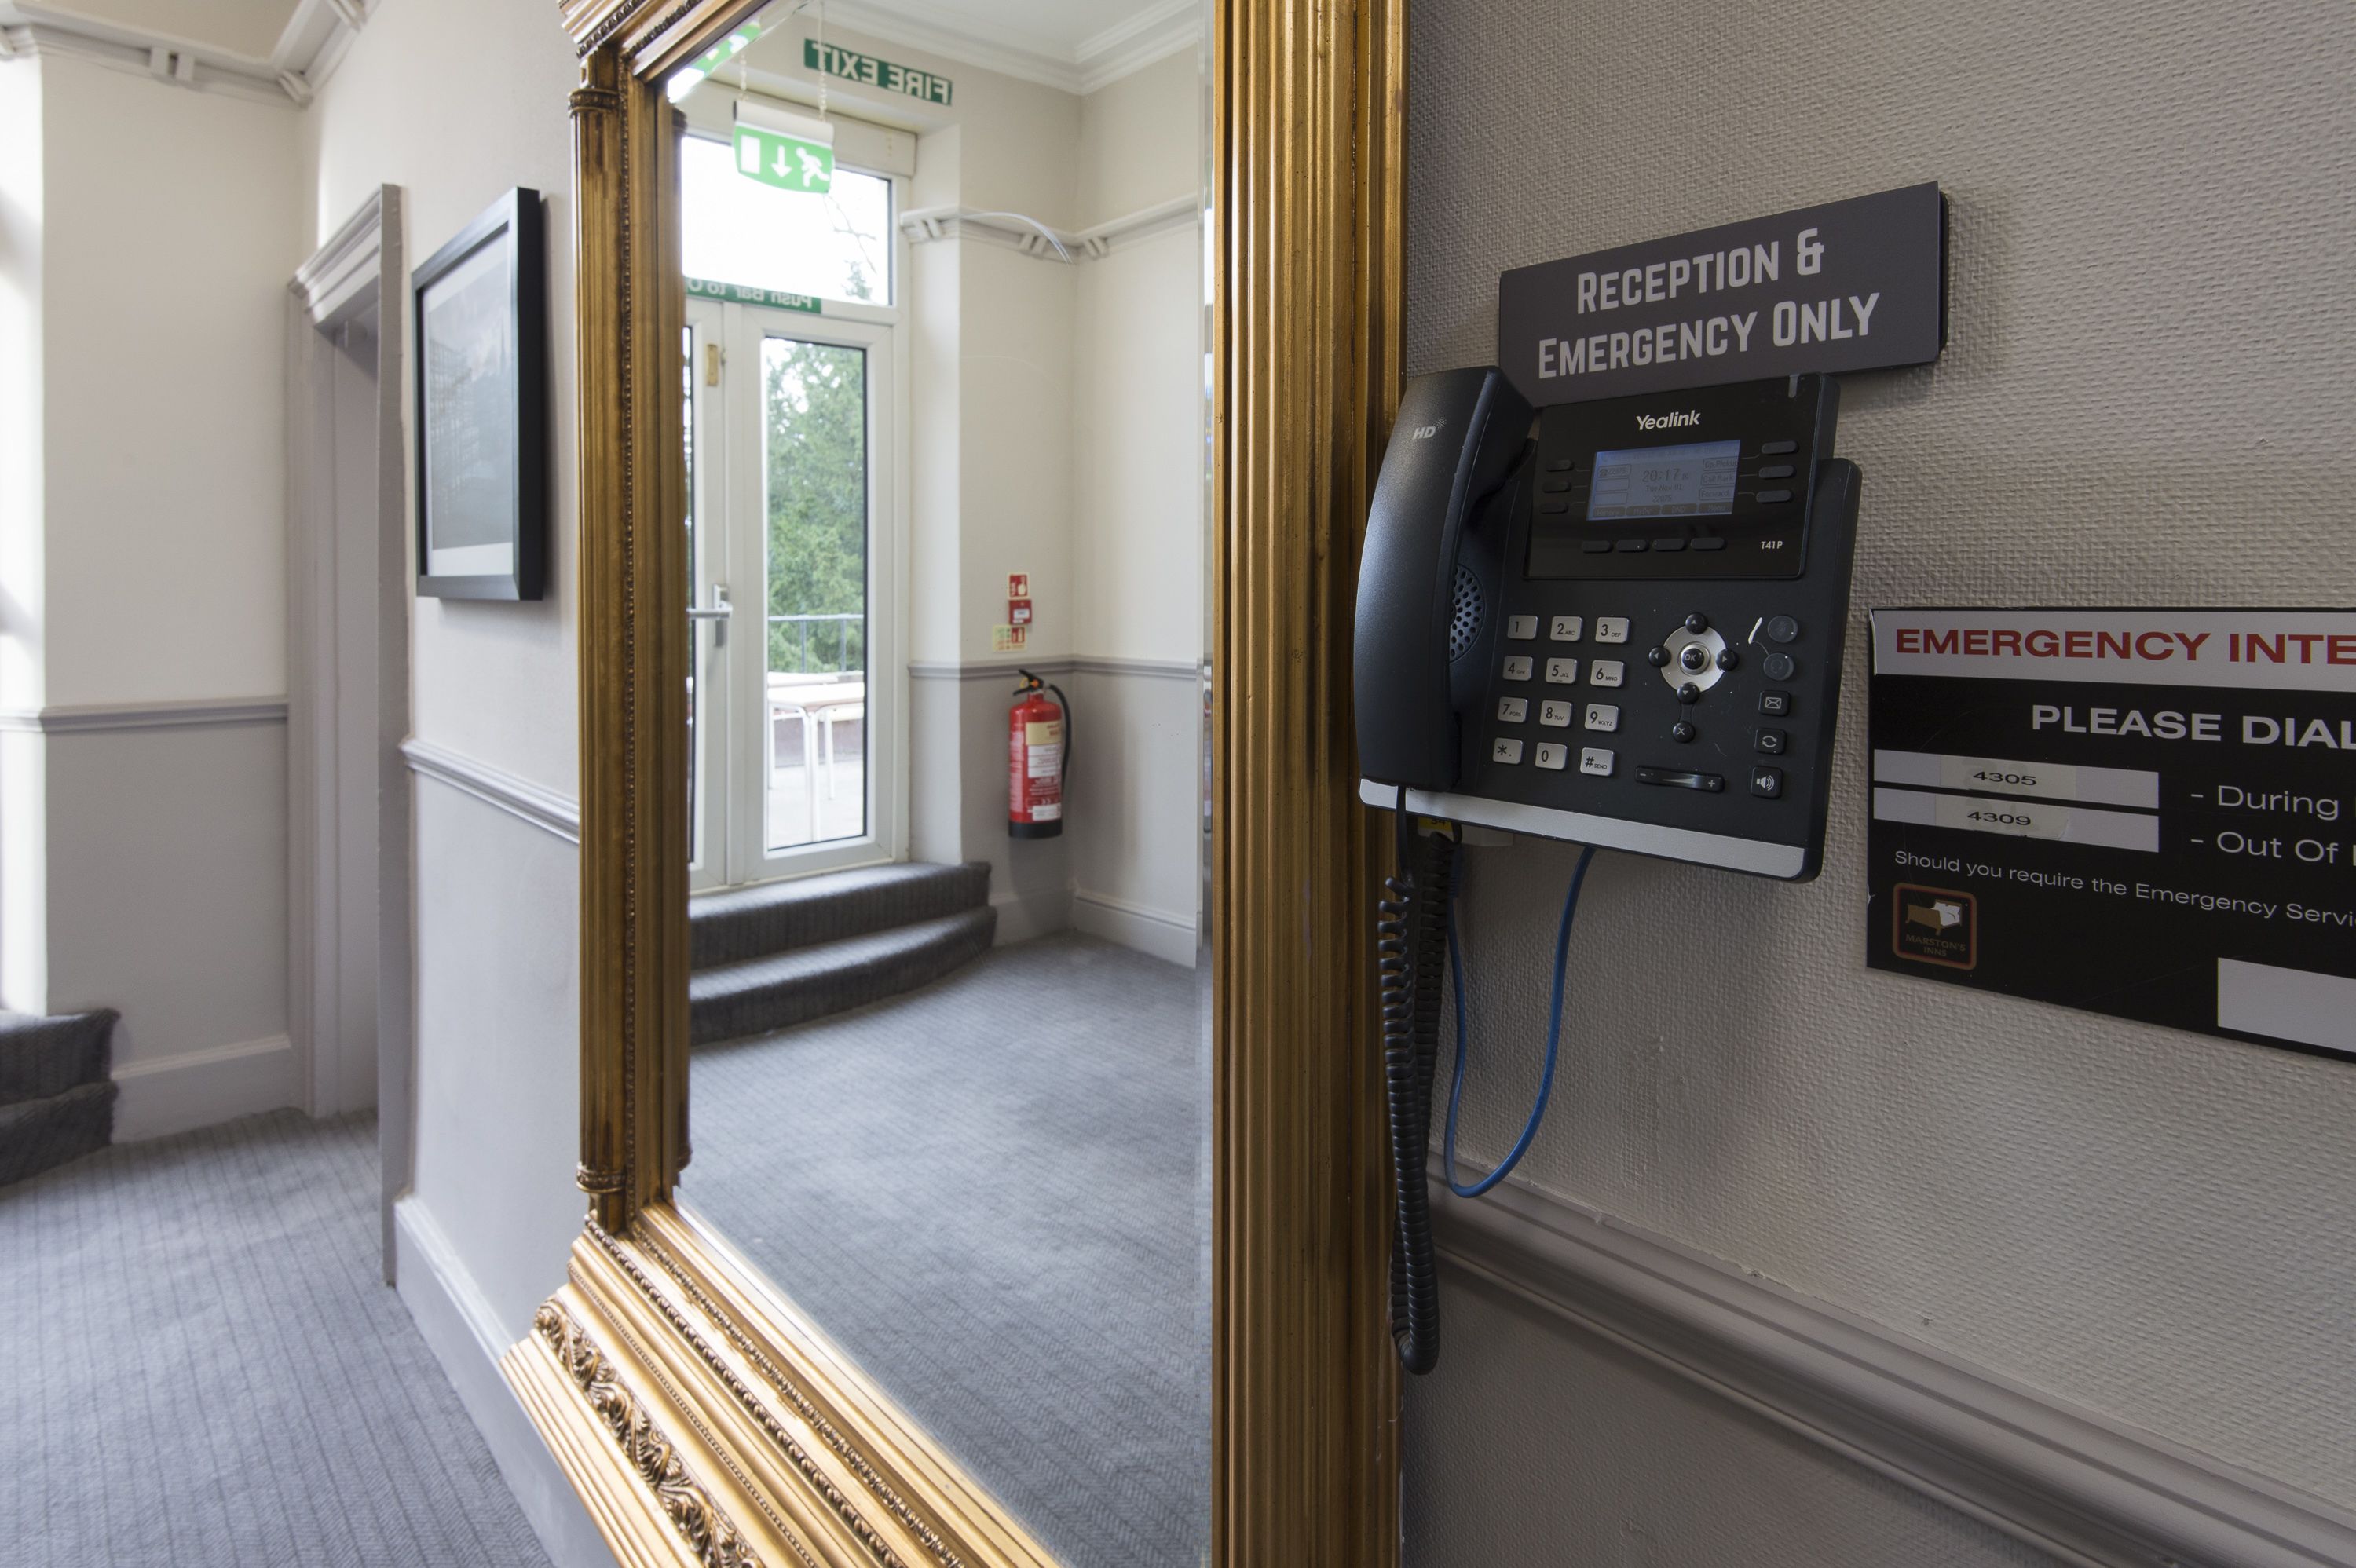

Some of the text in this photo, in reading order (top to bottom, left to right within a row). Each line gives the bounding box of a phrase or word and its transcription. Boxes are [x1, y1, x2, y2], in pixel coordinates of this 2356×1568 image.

[1577, 227, 1824, 314] RECEPTION &
[1538, 292, 1880, 379] EMERGENCY ONLY
[1636, 410, 1701, 431] Yealink
[1412, 426, 1436, 440] HD
[1642, 468, 1681, 482] 20:17
[1761, 540, 1783, 550] T41P
[1557, 623, 1564, 634] 2
[1601, 623, 1608, 637] 3
[1896, 628, 2356, 666] EMERGENCY INTE
[1684, 653, 1697, 662] OK
[1508, 662, 1515, 674] 4
[1552, 664, 1559, 677] 5
[1596, 667, 1604, 680] 6
[1503, 704, 1510, 715] 7
[1546, 707, 1553, 718] 8
[1590, 711, 1598, 724] 9
[2032, 704, 2356, 750] PLEASE DIAL
[1541, 750, 1549, 762] 0
[1585, 756, 1594, 768] #
[1973, 771, 2037, 787] 4305
[2217, 784, 2340, 821] During
[1966, 811, 2032, 826] 4309
[2216, 831, 2282, 859] Out
[2295, 839, 2339, 864] Of
[1895, 850, 2356, 928] Should you require the Emergency Servi
[1904, 934, 1966, 952] MARSTON'S
[1922, 947, 1948, 957] INNS
